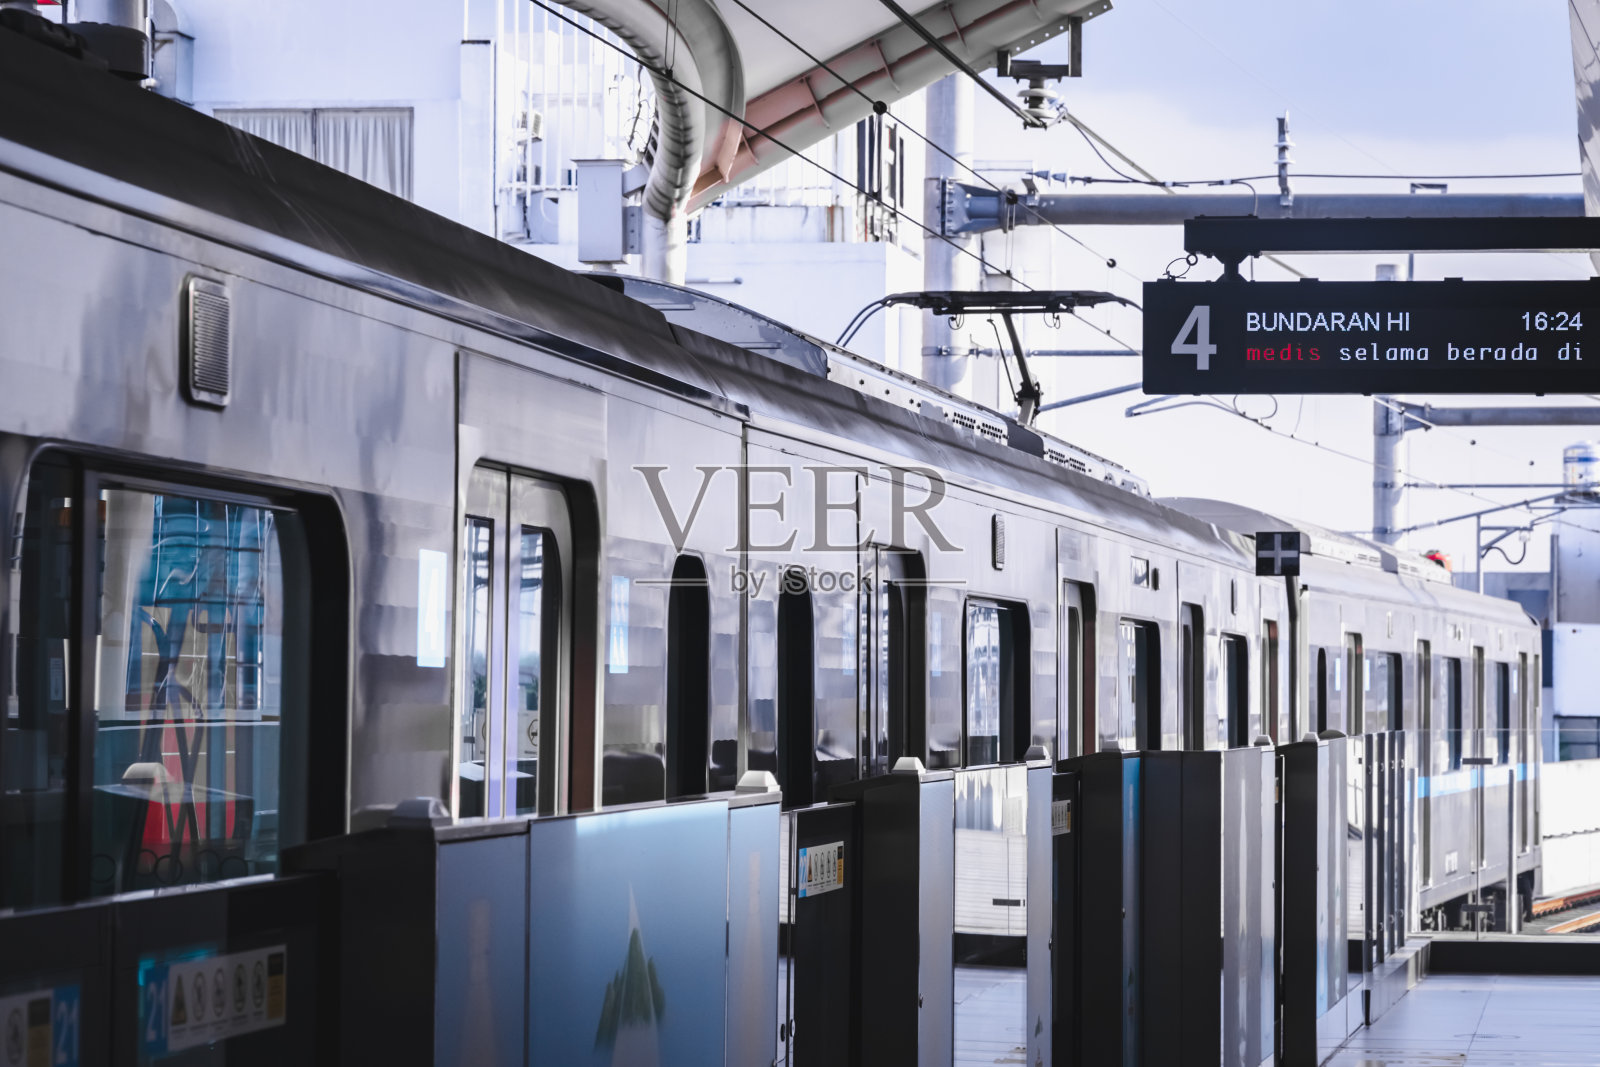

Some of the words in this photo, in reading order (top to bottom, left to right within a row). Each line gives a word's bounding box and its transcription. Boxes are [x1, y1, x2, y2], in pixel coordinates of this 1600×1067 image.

[1170, 305, 1218, 371] 4
[1246, 311, 1380, 332] BUNDARAN
[1387, 311, 1411, 332] HI
[1521, 311, 1584, 332] 16:24
[1246, 343, 1321, 362] medis
[1339, 343, 1429, 361] selama
[1447, 343, 1538, 361] berada
[1557, 343, 1583, 361] di
[55, 997, 80, 1065] 21
[145, 979, 167, 1043] 21
